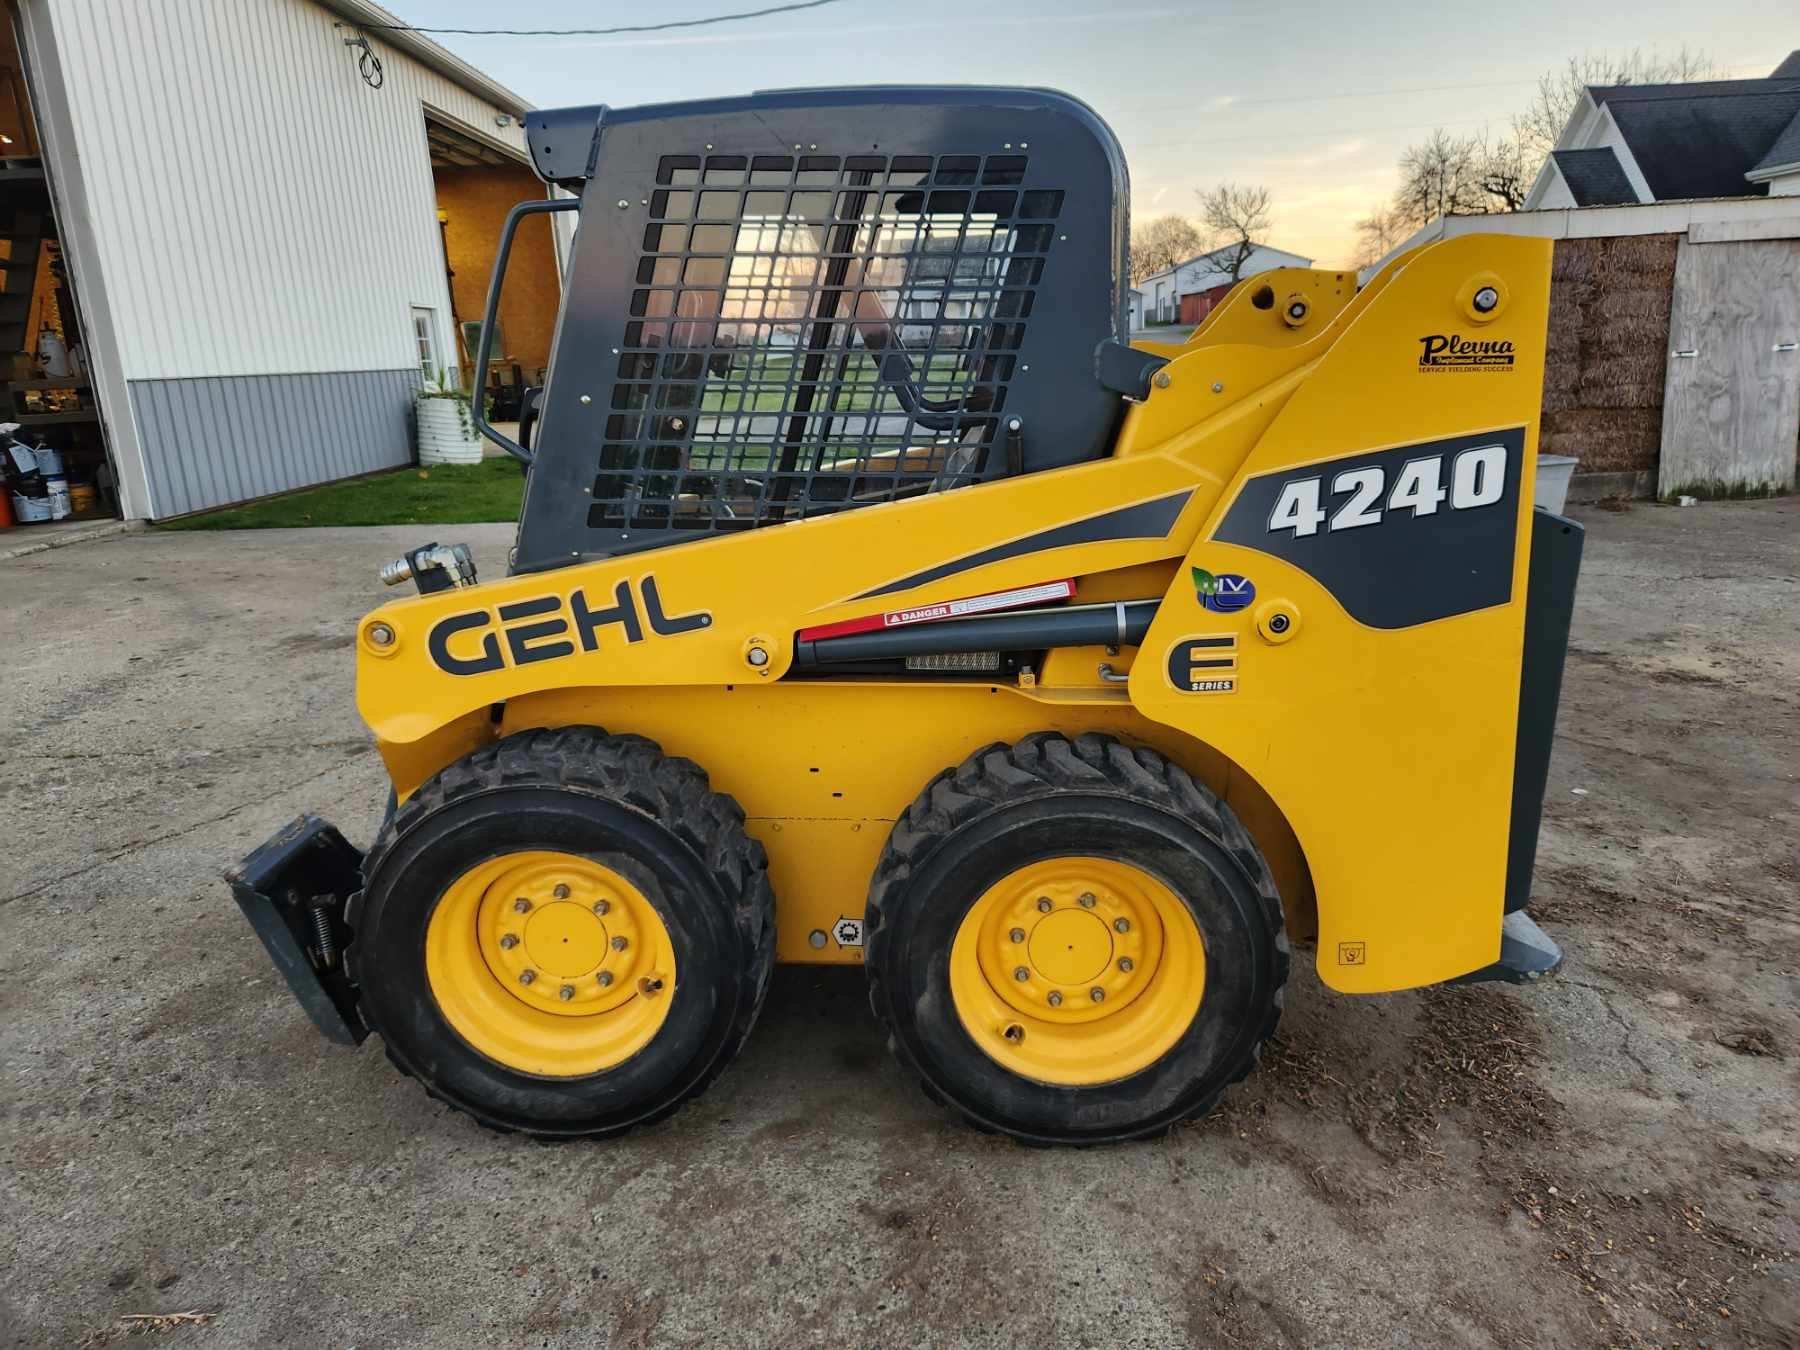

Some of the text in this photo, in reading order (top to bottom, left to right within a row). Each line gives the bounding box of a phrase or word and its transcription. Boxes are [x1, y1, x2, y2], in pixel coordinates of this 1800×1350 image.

[1419, 335, 1515, 365] Plevna
[1266, 444, 1508, 538] 4240
[428, 575, 713, 676] GEHL
[901, 606, 948, 622] DANGER
[1191, 681, 1232, 691] SERIES
